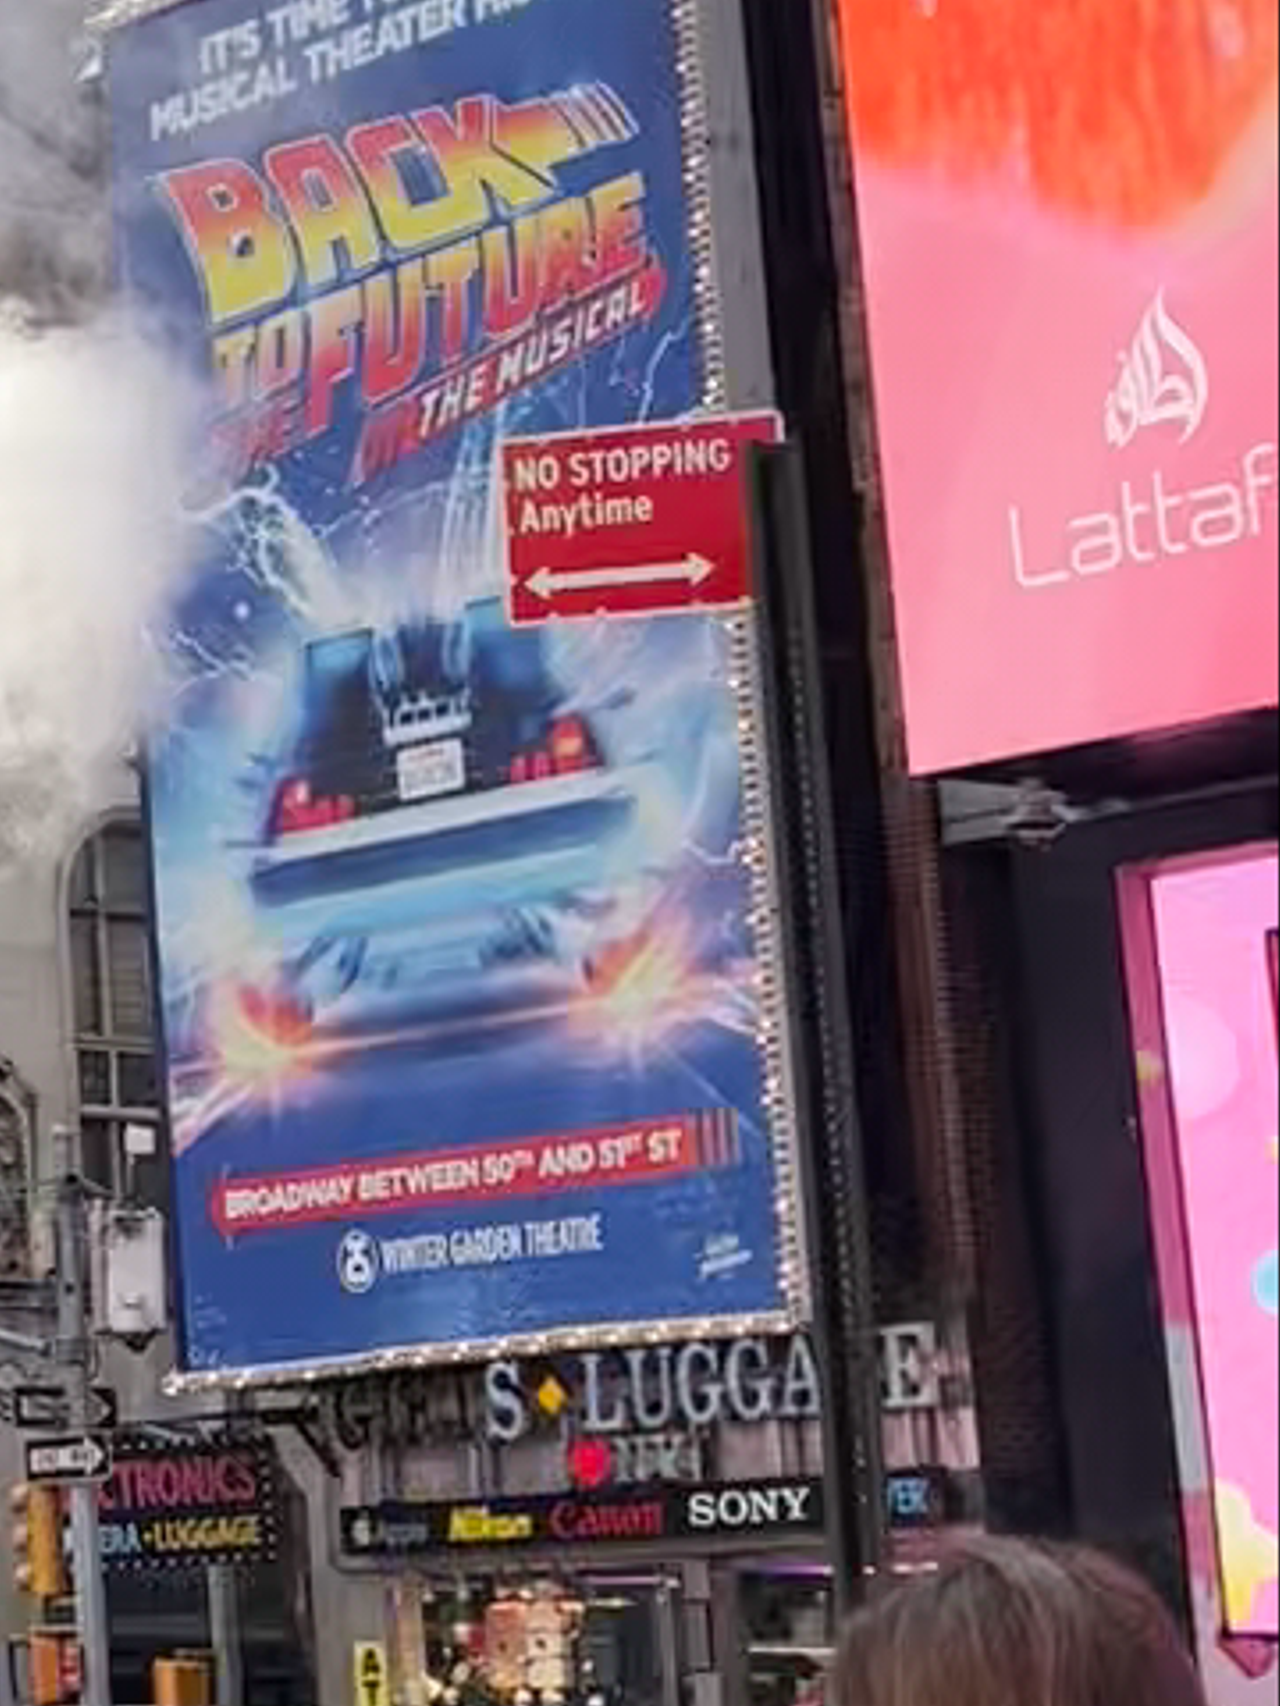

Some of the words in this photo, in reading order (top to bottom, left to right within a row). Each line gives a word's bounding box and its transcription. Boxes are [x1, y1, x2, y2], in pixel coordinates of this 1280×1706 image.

[198, 27, 262, 75] IT'S
[149, 60, 298, 142] MUSICAL
[149, 86, 625, 324] BACK
[212, 302, 303, 409] TO
[302, 172, 662, 441] FUTURE
[415, 368, 485, 437] THE
[493, 282, 648, 397] MUSICAL
[512, 453, 562, 493] NO
[569, 438, 732, 487] STOPPING
[519, 489, 654, 537] Anytime
[224, 1178, 356, 1221] BROADWAY
[357, 1160, 480, 1203] BETWEEN
[538, 1141, 598, 1178] AND
[645, 1128, 682, 1163] ST
[379, 1231, 449, 1273] WINTER
[450, 1223, 523, 1267] GARDEN
[583, 1321, 939, 1430] LUGGAE
[154, 1514, 262, 1551] LUGGAGE
[549, 1499, 664, 1538] Canon
[687, 1486, 811, 1528] SONY
